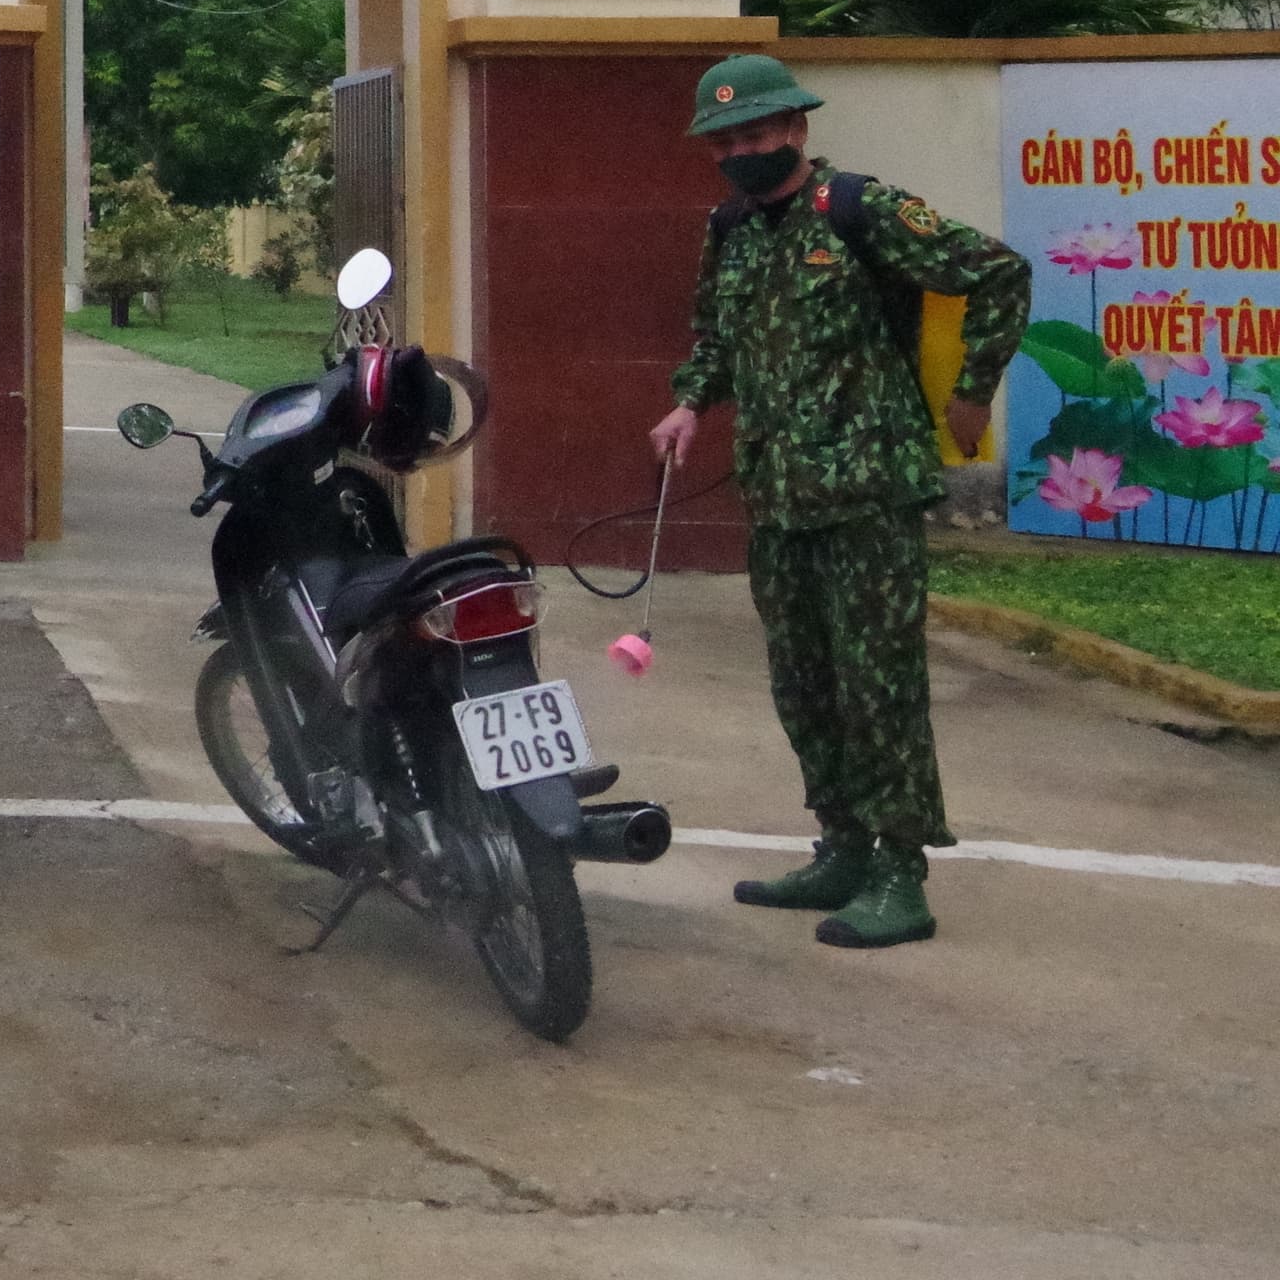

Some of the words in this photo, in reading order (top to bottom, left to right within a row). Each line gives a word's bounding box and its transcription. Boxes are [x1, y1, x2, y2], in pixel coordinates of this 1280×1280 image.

[1022, 129, 1083, 184] CÁN
[1093, 129, 1142, 193] BỘ,
[1153, 121, 1250, 184] CHIẾN
[1137, 219, 1180, 267] TƯ
[1104, 289, 1205, 355] QUYẾT
[487, 729, 577, 780] 2069
